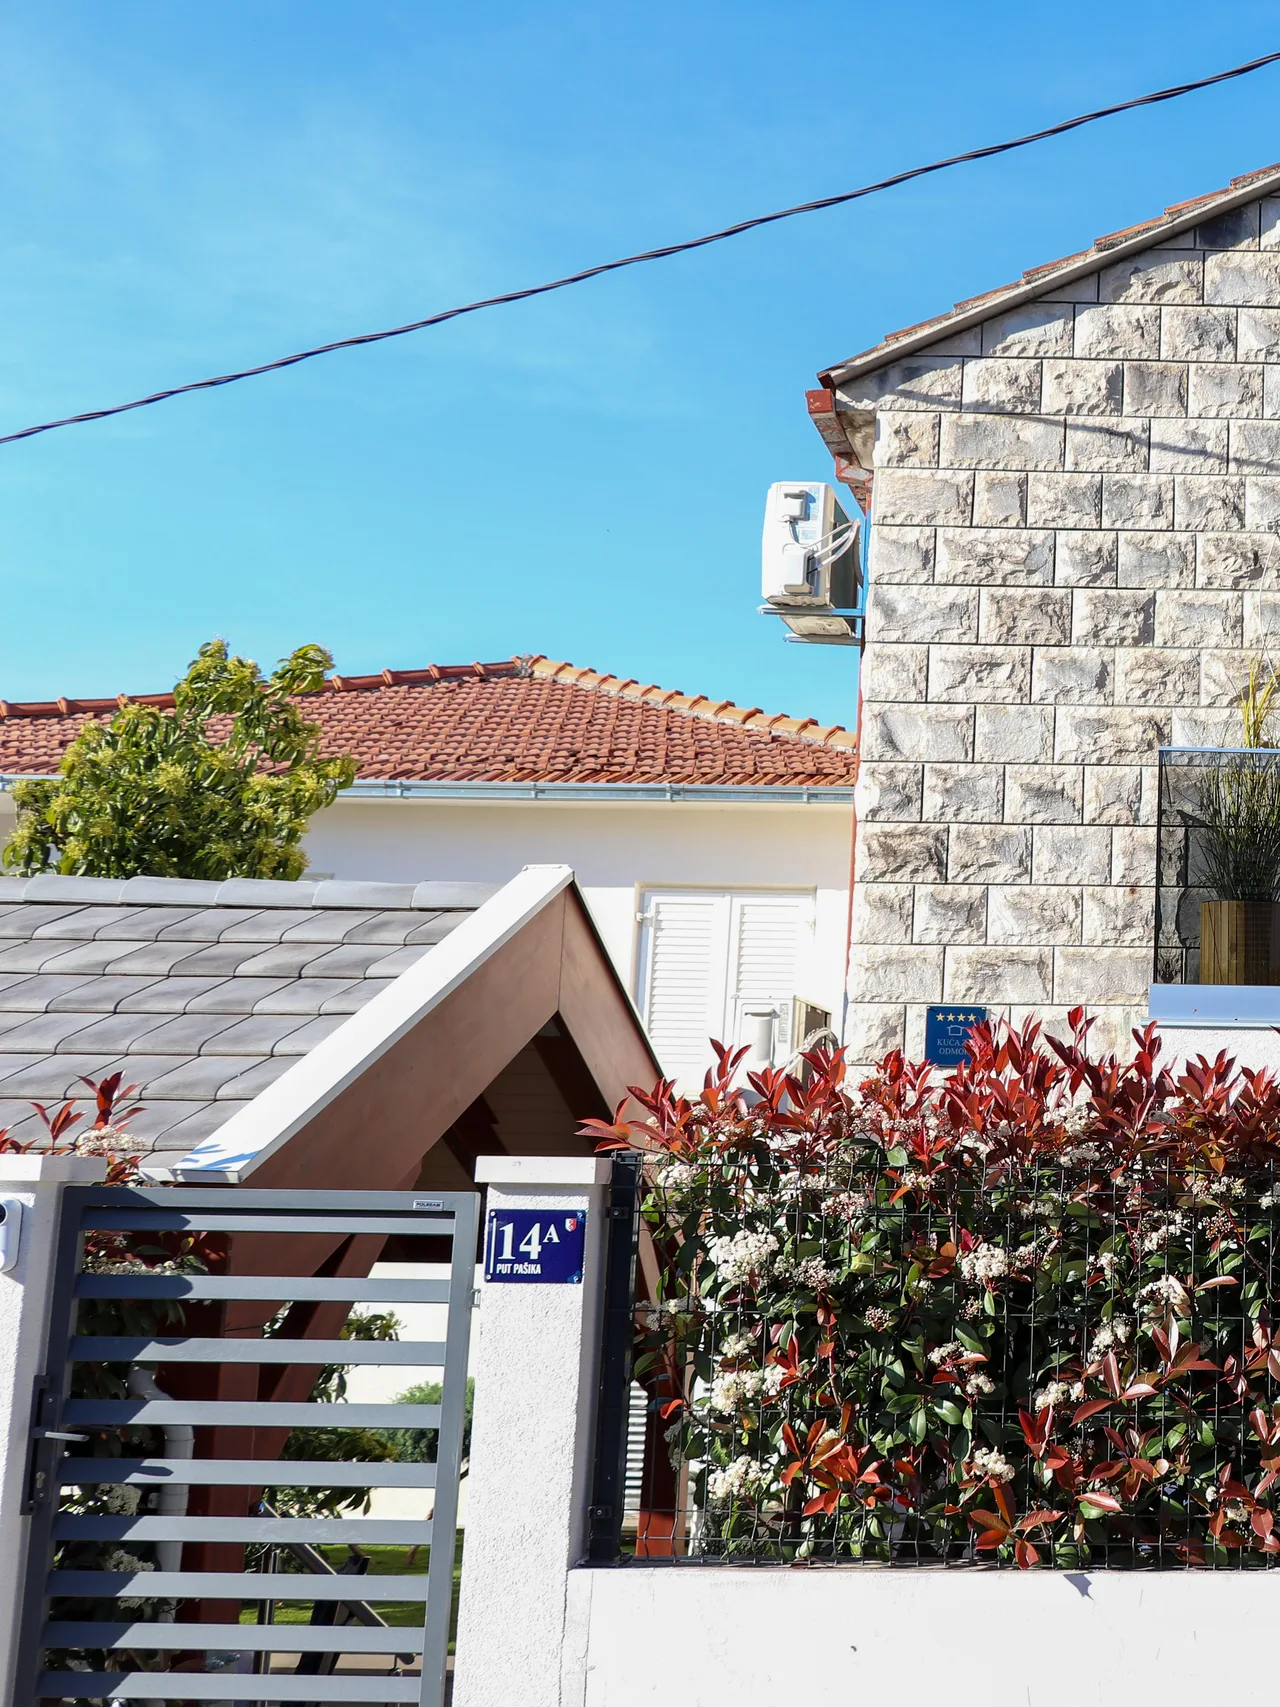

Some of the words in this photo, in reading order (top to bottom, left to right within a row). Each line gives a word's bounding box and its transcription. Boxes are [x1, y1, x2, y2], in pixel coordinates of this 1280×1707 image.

[937, 1037, 960, 1046] KUĆA
[496, 1263, 512, 1274] PUT
[513, 1262, 541, 1274] PAŠIKA
